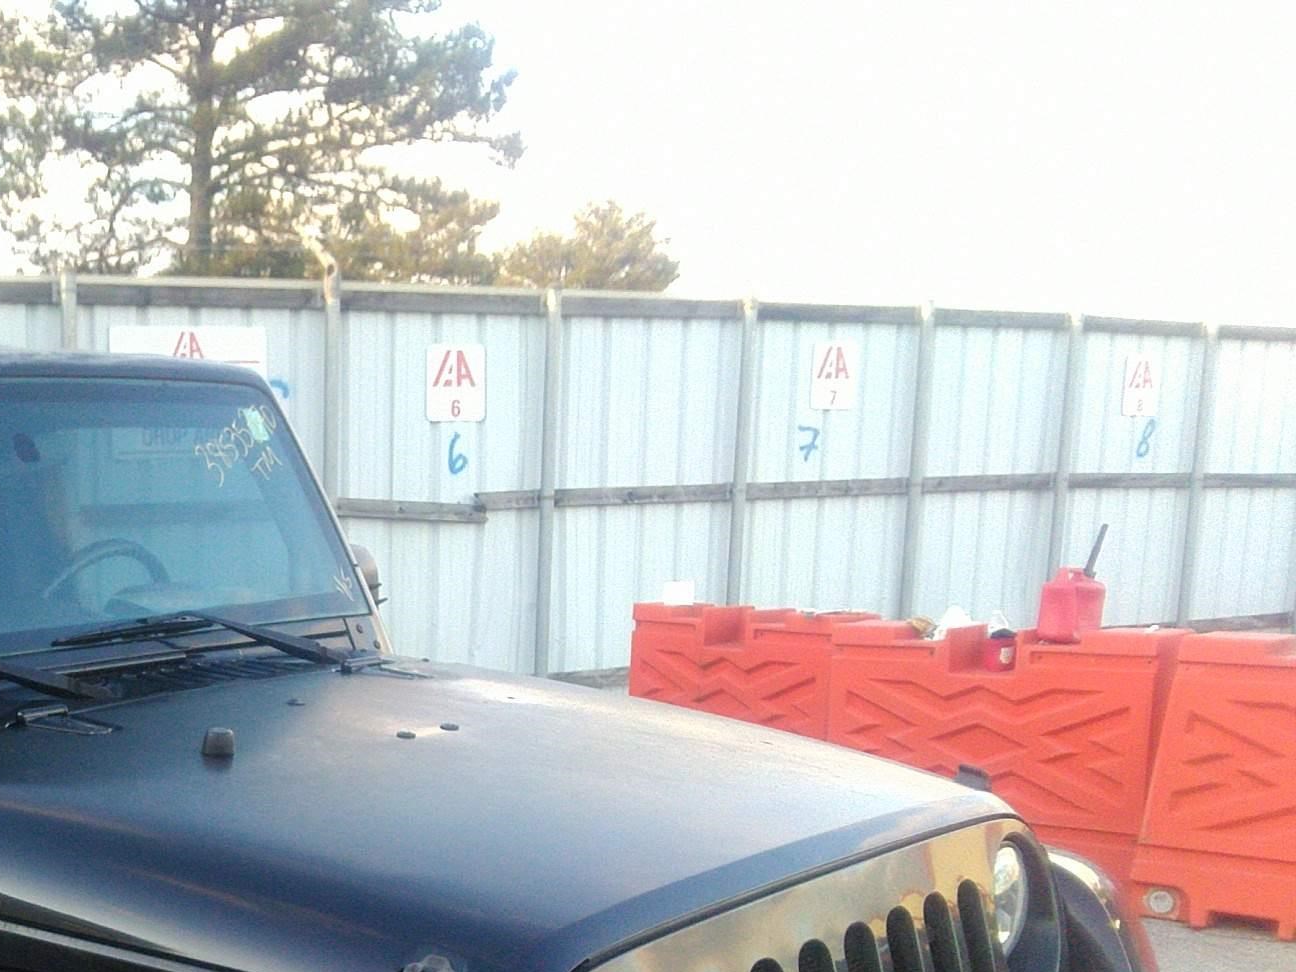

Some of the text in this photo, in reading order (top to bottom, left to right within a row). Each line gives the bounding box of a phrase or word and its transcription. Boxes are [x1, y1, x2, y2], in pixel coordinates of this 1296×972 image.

[451, 399, 461, 417] 6
[830, 390, 837, 405] 7
[194, 404, 277, 488] 385350
[448, 431, 468, 474] 6
[798, 425, 820, 462] 7
[1136, 418, 1156, 457] 8
